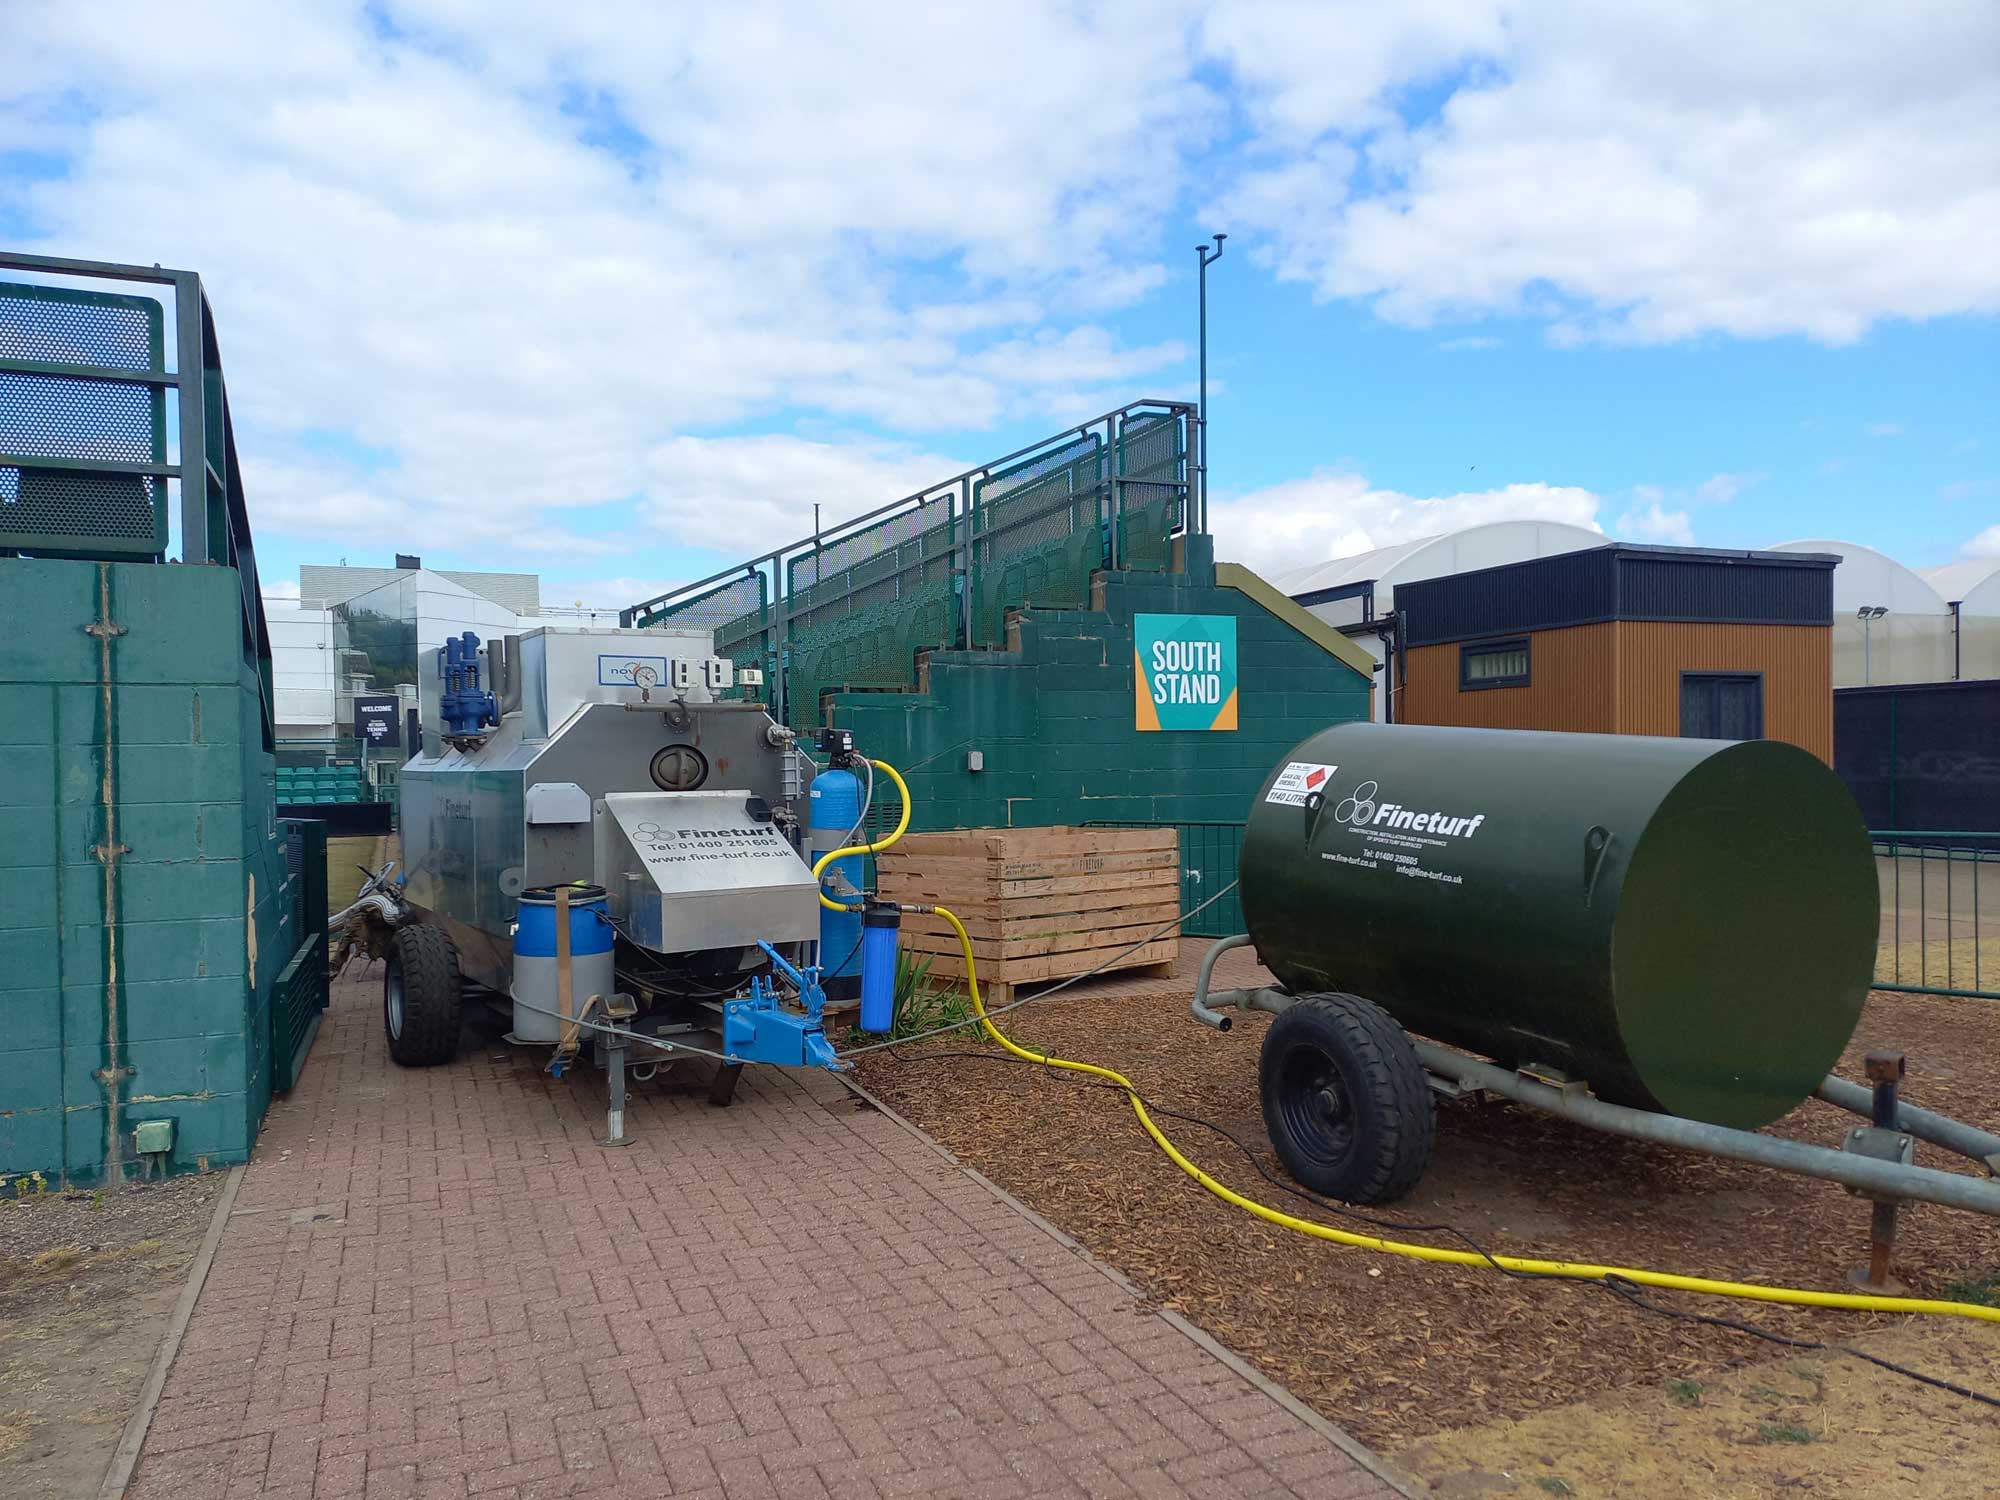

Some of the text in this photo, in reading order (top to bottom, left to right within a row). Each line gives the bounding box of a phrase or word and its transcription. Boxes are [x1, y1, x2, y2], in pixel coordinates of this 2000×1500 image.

[1152, 640, 1221, 672] SOUTH
[1153, 673, 1220, 704] STAND
[1279, 779, 1297, 787] DIESEL
[1269, 791, 1308, 804] 1140 LITR
[1372, 803, 1485, 838] Fineturf
[676, 827, 775, 839] Fineturf
[648, 839, 778, 852] Tel: 01400 251605
[649, 850, 793, 864] www.fine-turf.co.uk
[1363, 849, 1375, 858] Tel:
[1375, 851, 1394, 862] 01400
[1321, 852, 1463, 884] www.fine-turf.co.uk info@fine-turf.co.uk
